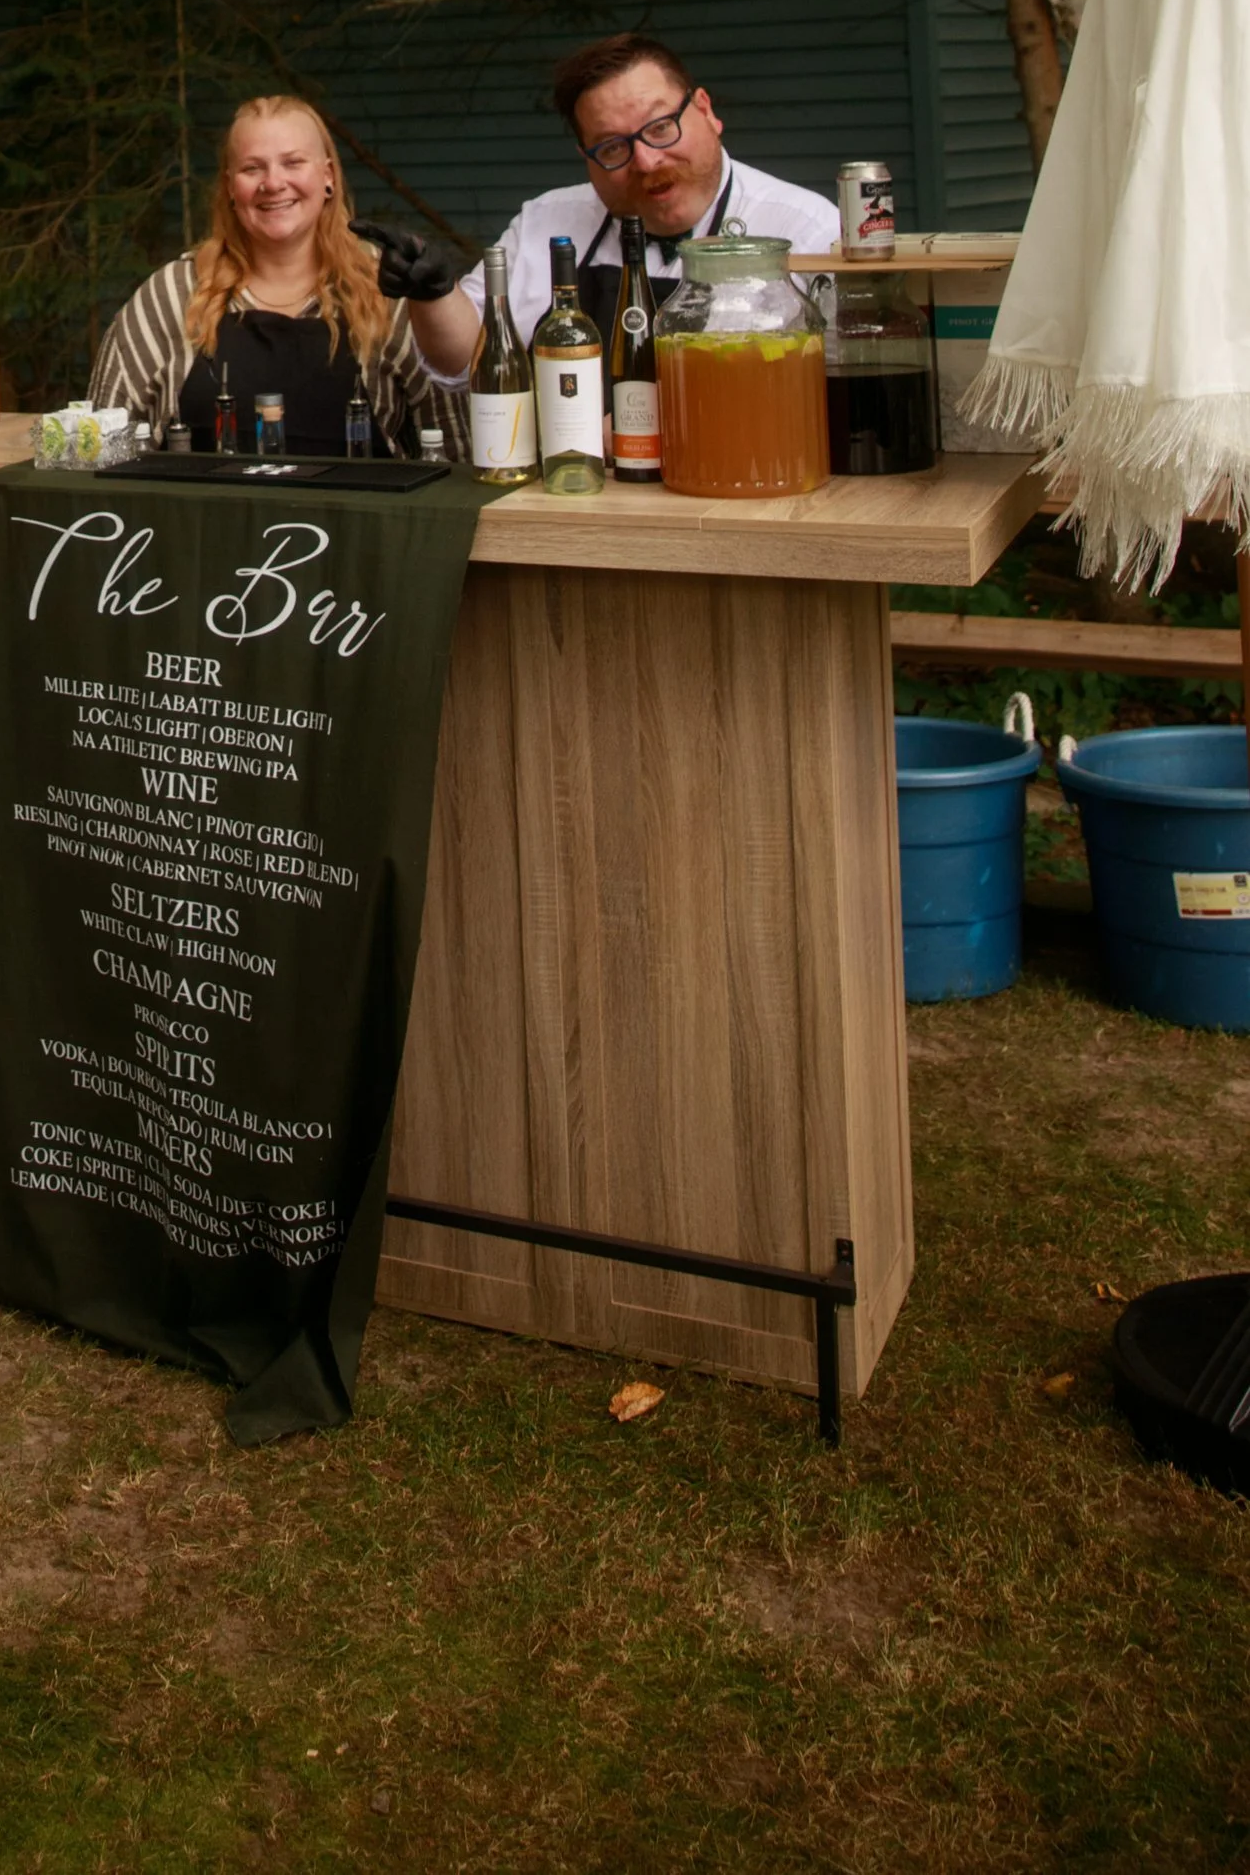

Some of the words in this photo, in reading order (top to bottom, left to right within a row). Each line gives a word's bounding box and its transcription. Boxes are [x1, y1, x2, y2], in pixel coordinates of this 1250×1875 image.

[11, 511, 179, 621] The
[205, 523, 387, 657] Bar
[44, 676, 106, 700] MILLER
[108, 684, 140, 705] LITE
[150, 691, 221, 716] LABATT
[224, 701, 270, 724] BLUE
[273, 707, 327, 731] LIGHT
[145, 651, 223, 687] BEER
[72, 730, 96, 749] NA
[99, 734, 177, 764] ATHLETIC
[180, 748, 262, 776] BREWING
[266, 760, 299, 781] IPA
[145, 716, 200, 740] LIGHT
[209, 726, 285, 753] OBERON
[47, 785, 134, 819] SAUVIGNON
[135, 803, 194, 830] BLANC
[205, 815, 255, 841] PINOT
[257, 825, 319, 852] GRIGIO
[141, 766, 219, 804] WINE
[13, 804, 78, 832] RIESLING
[86, 819, 200, 856] CHARDONNAY
[210, 843, 253, 868] ROSE
[264, 853, 305, 876] RED
[307, 860, 353, 887] BLEND
[47, 834, 88, 858] PINOT
[89, 845, 125, 867] NIOR
[133, 855, 221, 887] CABERNET
[224, 872, 323, 909] SAUVIGNON
[80, 909, 125, 938] WHITE
[126, 925, 169, 951] CLAW
[177, 939, 225, 964] HIGH
[228, 948, 276, 977] NOON
[111, 882, 240, 937] SELTZERS
[93, 949, 253, 1022] CHAMPAGNE
[40, 1038, 99, 1067] VODKA
[169, 1088, 239, 1125] TEQUILA
[242, 1111, 324, 1139] BLANCO
[71, 1069, 136, 1105] TEQUILA
[210, 1127, 247, 1156] RUM
[256, 1143, 294, 1164] GIN
[30, 1121, 86, 1146] TONIC
[89, 1131, 143, 1164] WATER
[174, 1175, 213, 1208] SODA
[223, 1195, 265, 1215] DIET
[269, 1201, 327, 1222] COKE
[137, 1112, 212, 1176] MIXERS
[11, 1167, 109, 1203] LEMONADE
[117, 1191, 188, 1246] CRANBRY
[189, 1234, 240, 1258] JUICE
[21, 1145, 73, 1168] COKE
[83, 1155, 136, 1186] SPRITE
[242, 1218, 336, 1245] VERNORS
